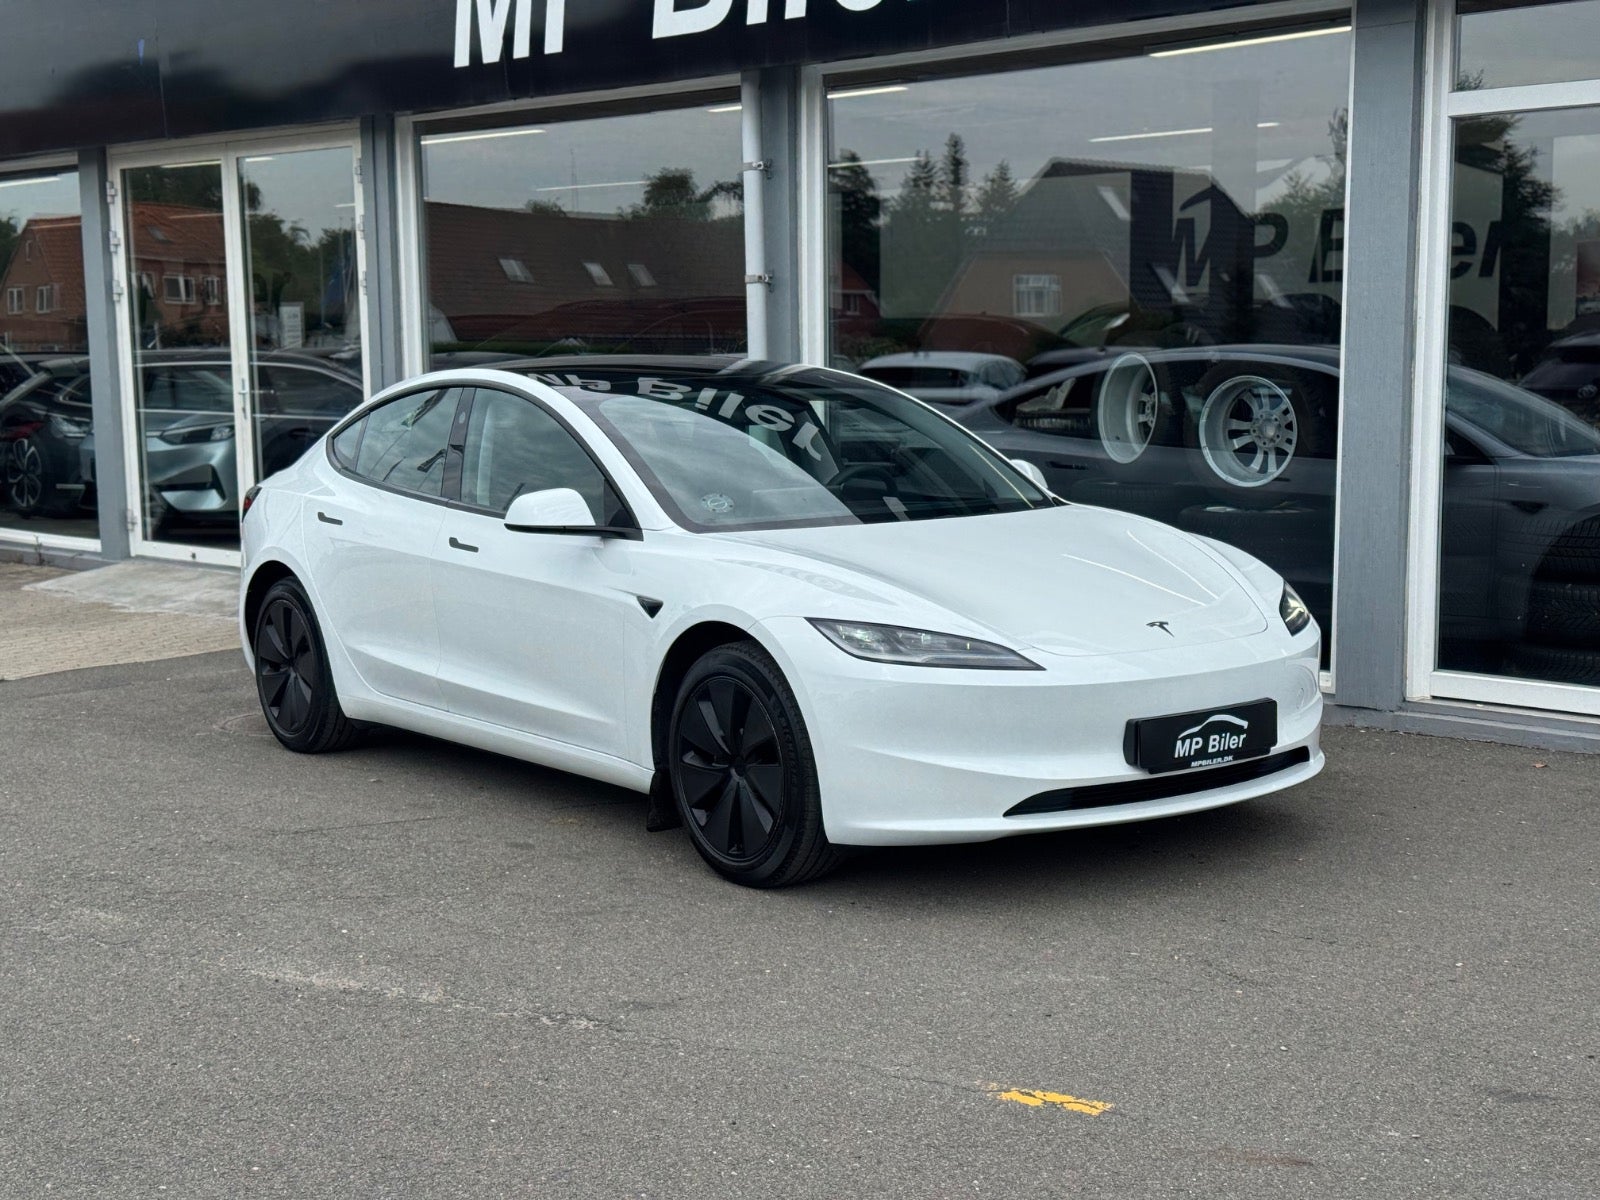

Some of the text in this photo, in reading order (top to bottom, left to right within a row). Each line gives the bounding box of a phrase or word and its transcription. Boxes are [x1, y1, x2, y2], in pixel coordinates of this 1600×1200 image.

[1175, 732, 1247, 758] MP Biler
[1190, 755, 1234, 767] MPBILER.DK
